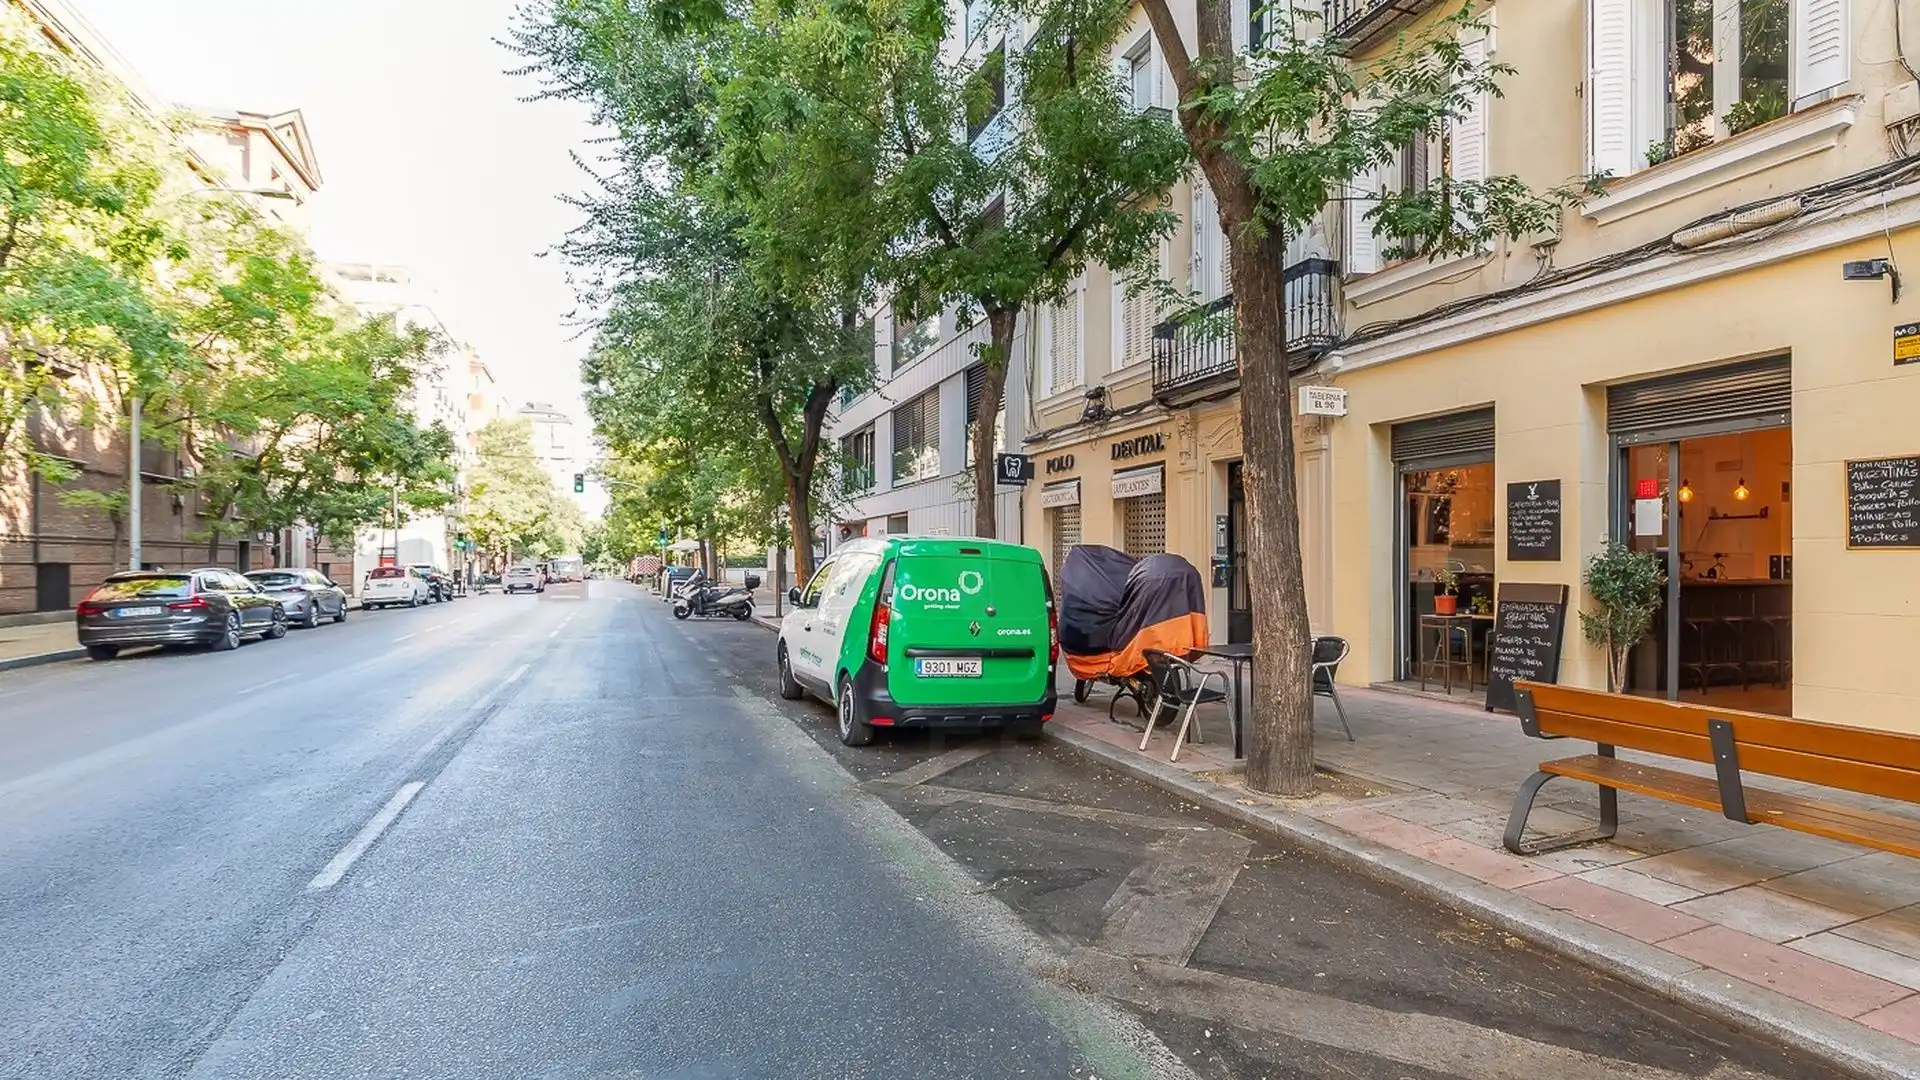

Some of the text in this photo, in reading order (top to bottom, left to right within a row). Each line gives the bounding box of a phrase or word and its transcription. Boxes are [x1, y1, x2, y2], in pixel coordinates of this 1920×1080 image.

[1309, 391, 1341, 401] TABERNA
[1314, 400, 1323, 409] EL
[1111, 432, 1165, 461] DENTAL
[1045, 453, 1076, 475] POLO
[1852, 466, 1919, 481] ARGENTINAS
[1113, 478, 1150, 494] IMPLANTES
[900, 584, 961, 601] Orona
[997, 628, 1032, 636] orona.es
[925, 662, 977, 673] 9301 MGZ
